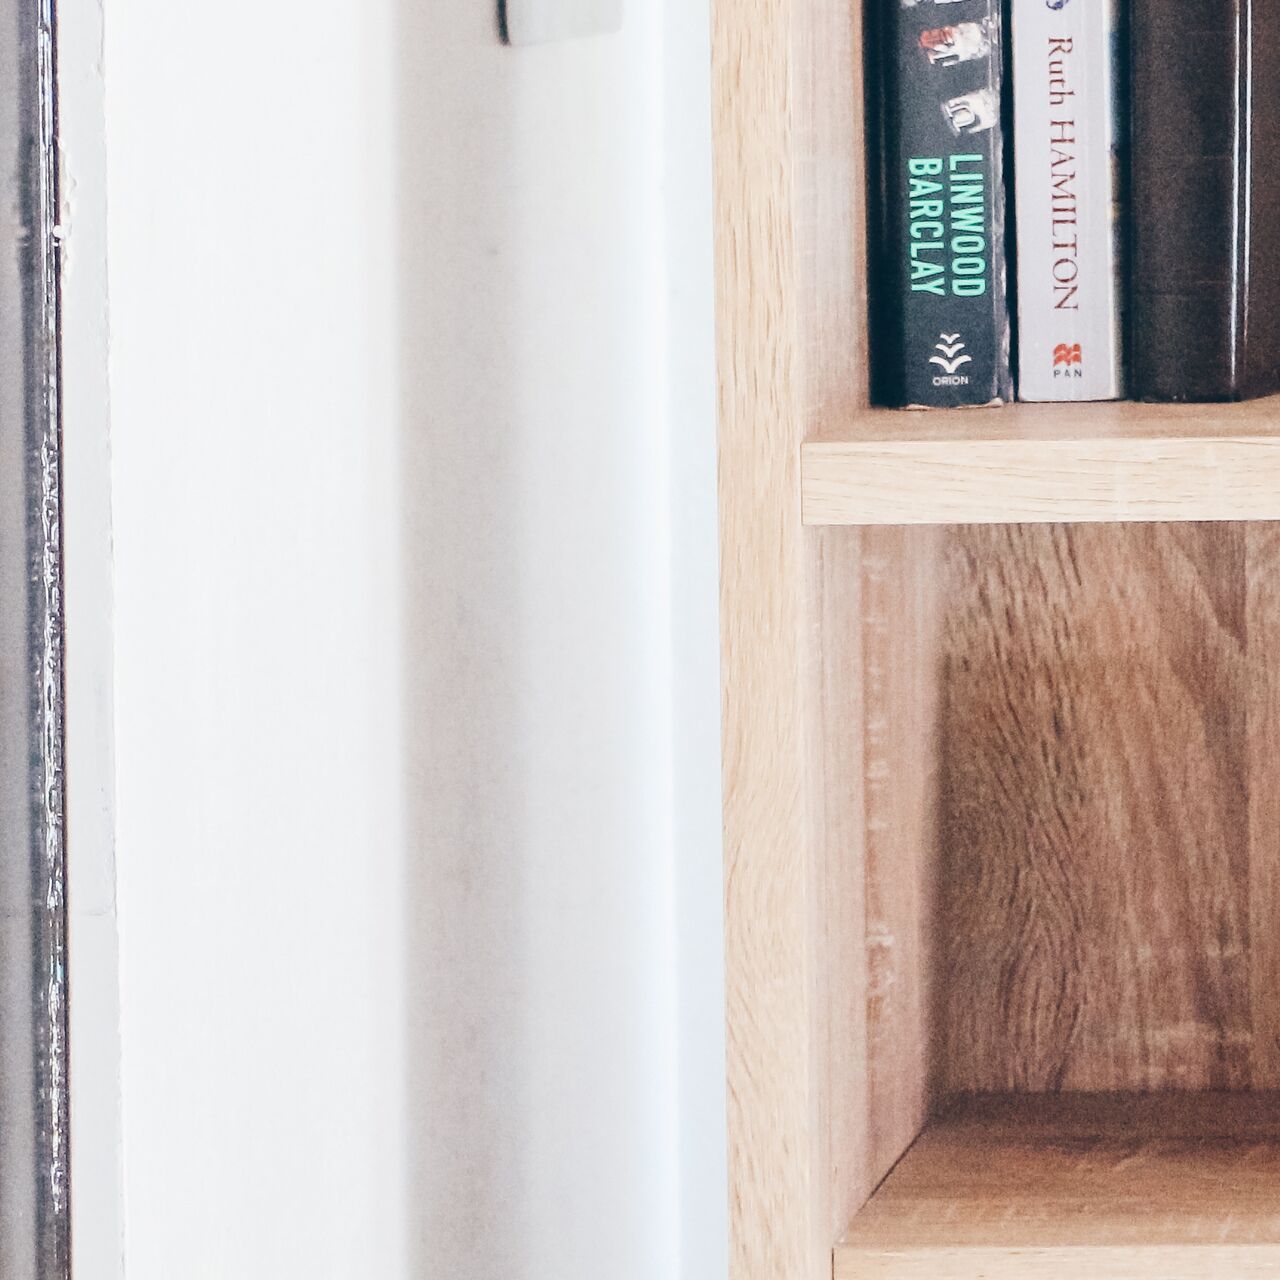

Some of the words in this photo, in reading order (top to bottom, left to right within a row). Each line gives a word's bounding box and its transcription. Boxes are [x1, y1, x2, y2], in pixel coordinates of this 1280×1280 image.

[1047, 36, 1074, 106] Ruth
[909, 157, 945, 297] BARCLAY
[948, 154, 985, 297] LINWOOD
[1050, 120, 1079, 311] HAMILTON
[932, 376, 969, 386] ORION
[1053, 368, 1082, 378] PAN
